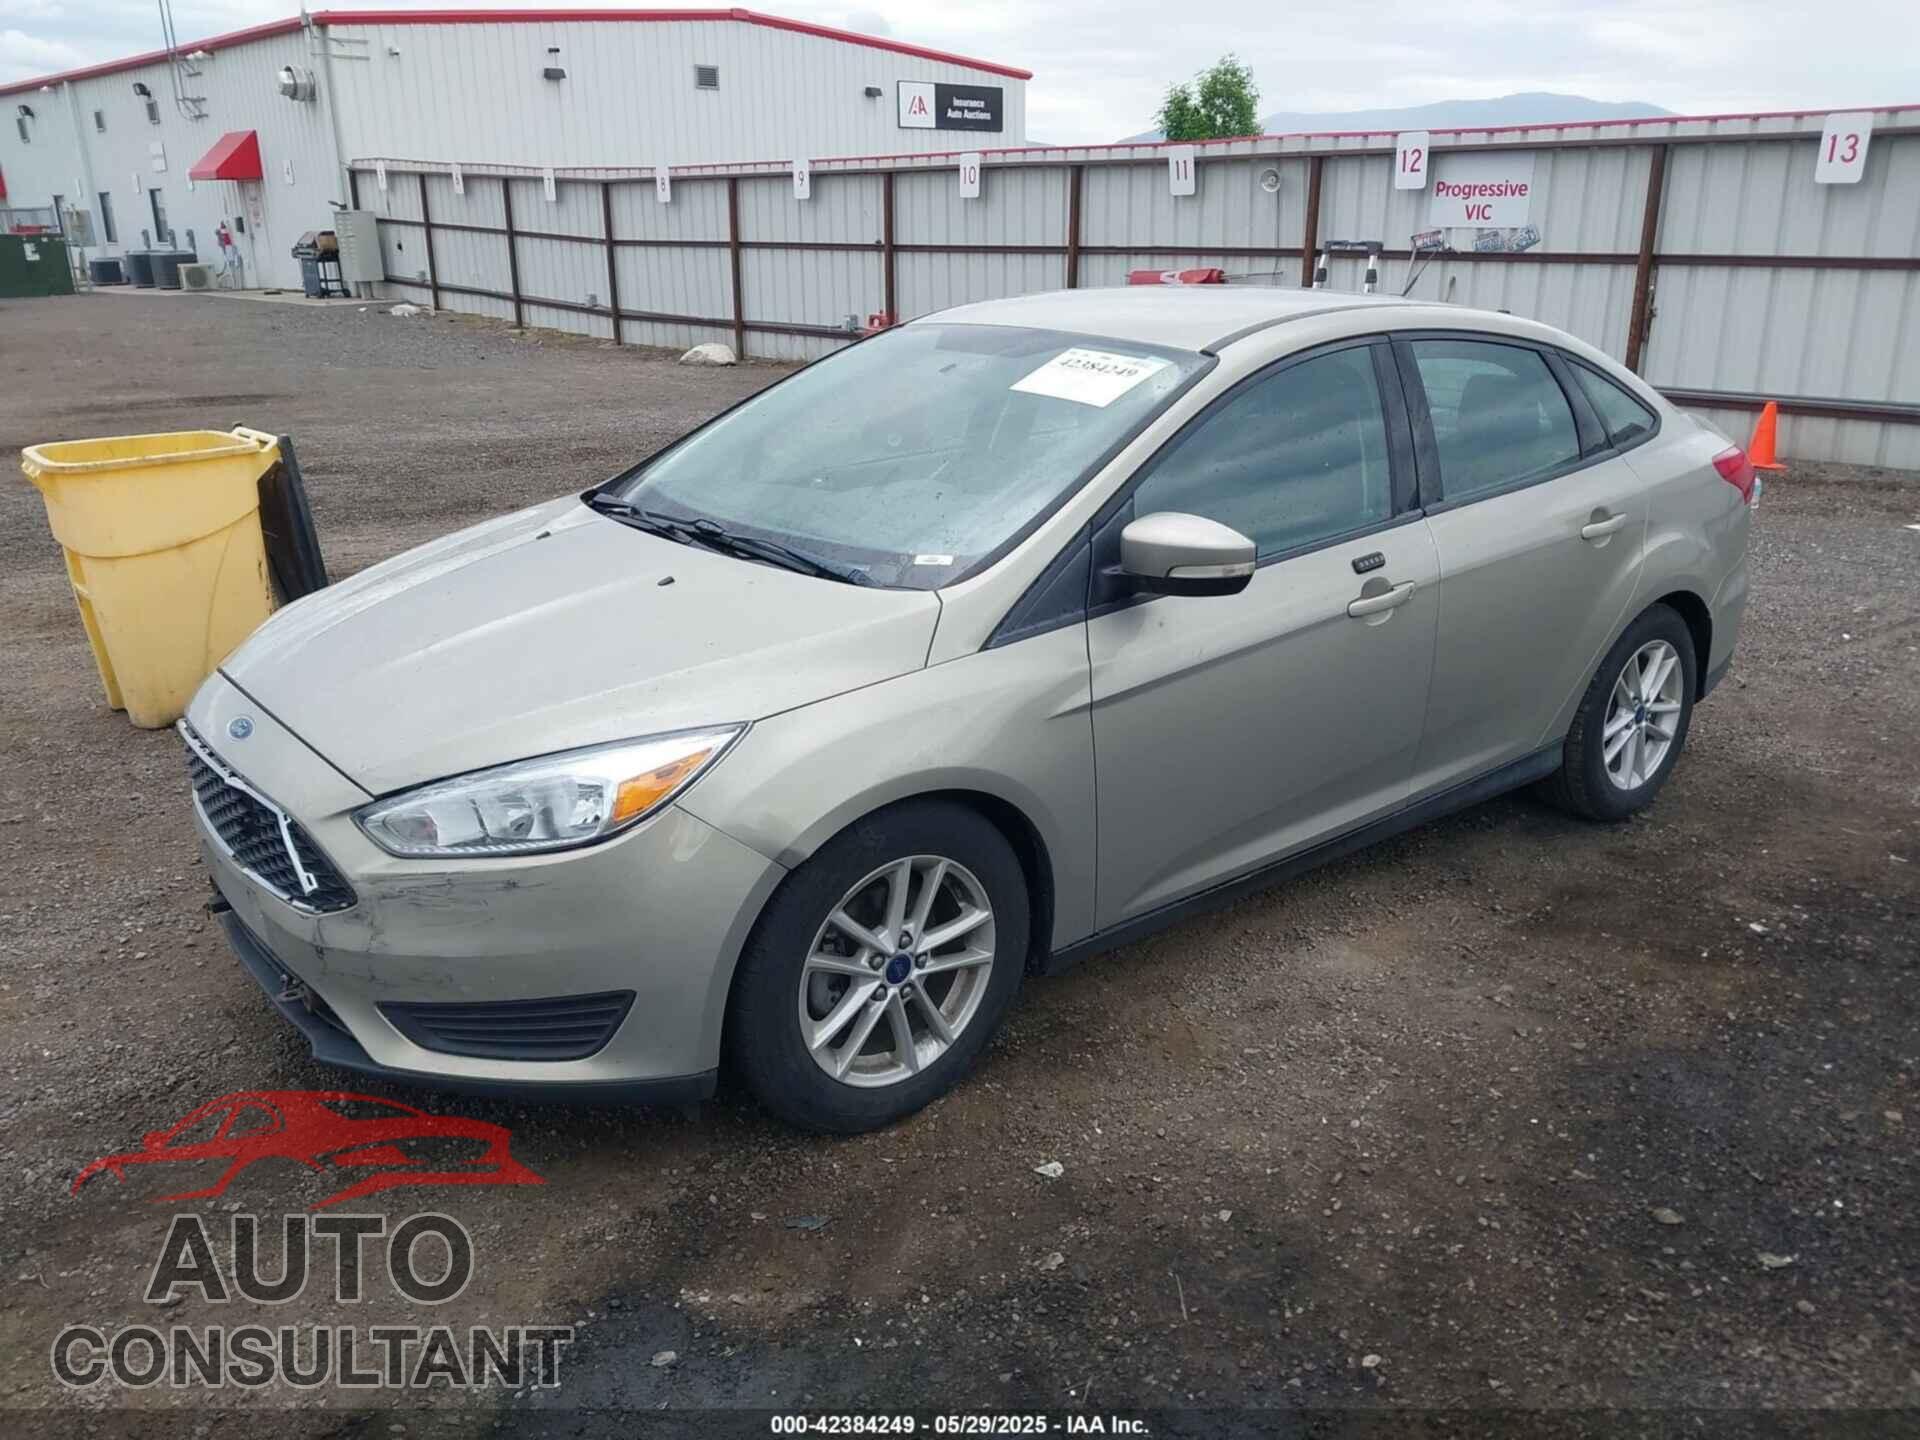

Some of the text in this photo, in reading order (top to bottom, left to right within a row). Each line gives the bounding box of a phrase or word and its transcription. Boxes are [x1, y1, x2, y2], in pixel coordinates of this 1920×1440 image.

[952, 96, 985, 109] Insurance
[946, 107, 991, 120] Auto Auctions
[1827, 133, 1860, 164] 13
[1176, 159, 1188, 181] 11
[1402, 148, 1423, 173] 12
[798, 170, 805, 187] 9
[963, 165, 977, 185] 10
[1435, 179, 1529, 200] Progressive
[1464, 203, 1493, 221] VIC
